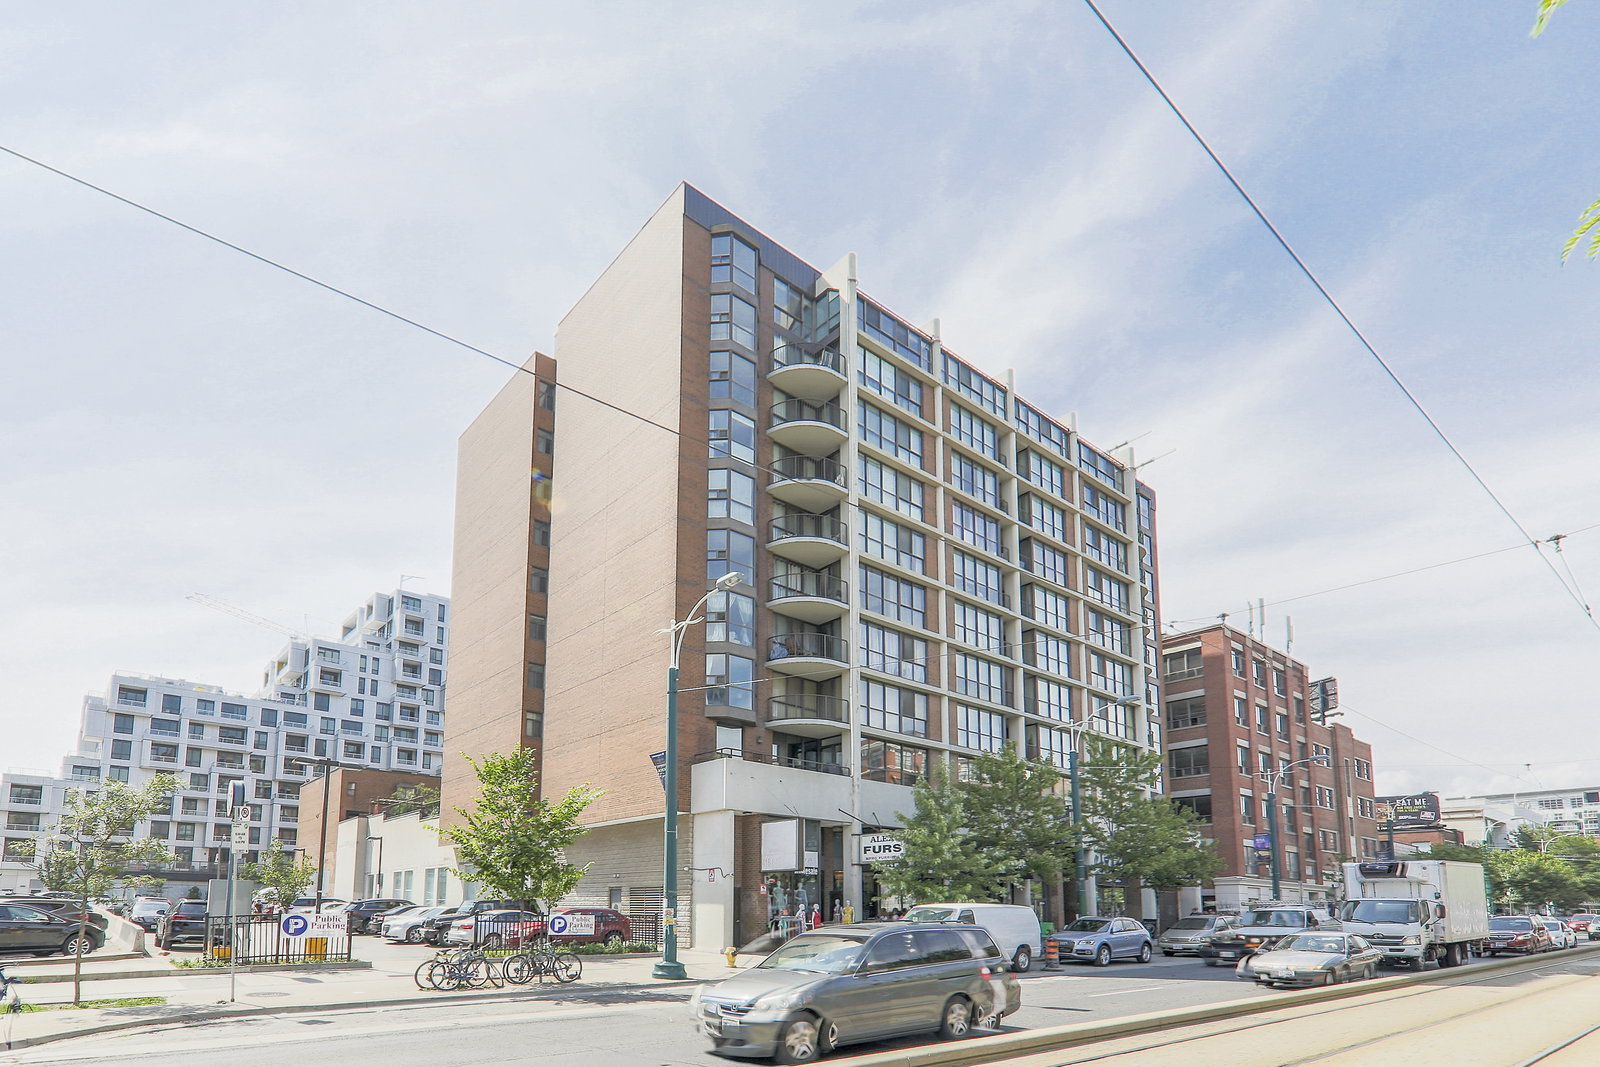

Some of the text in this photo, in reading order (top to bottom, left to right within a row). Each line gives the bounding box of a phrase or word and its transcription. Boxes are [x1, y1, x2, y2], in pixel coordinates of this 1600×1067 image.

[863, 843, 902, 855] FURS
[315, 915, 342, 923] Public
[311, 922, 346, 930] Parking
